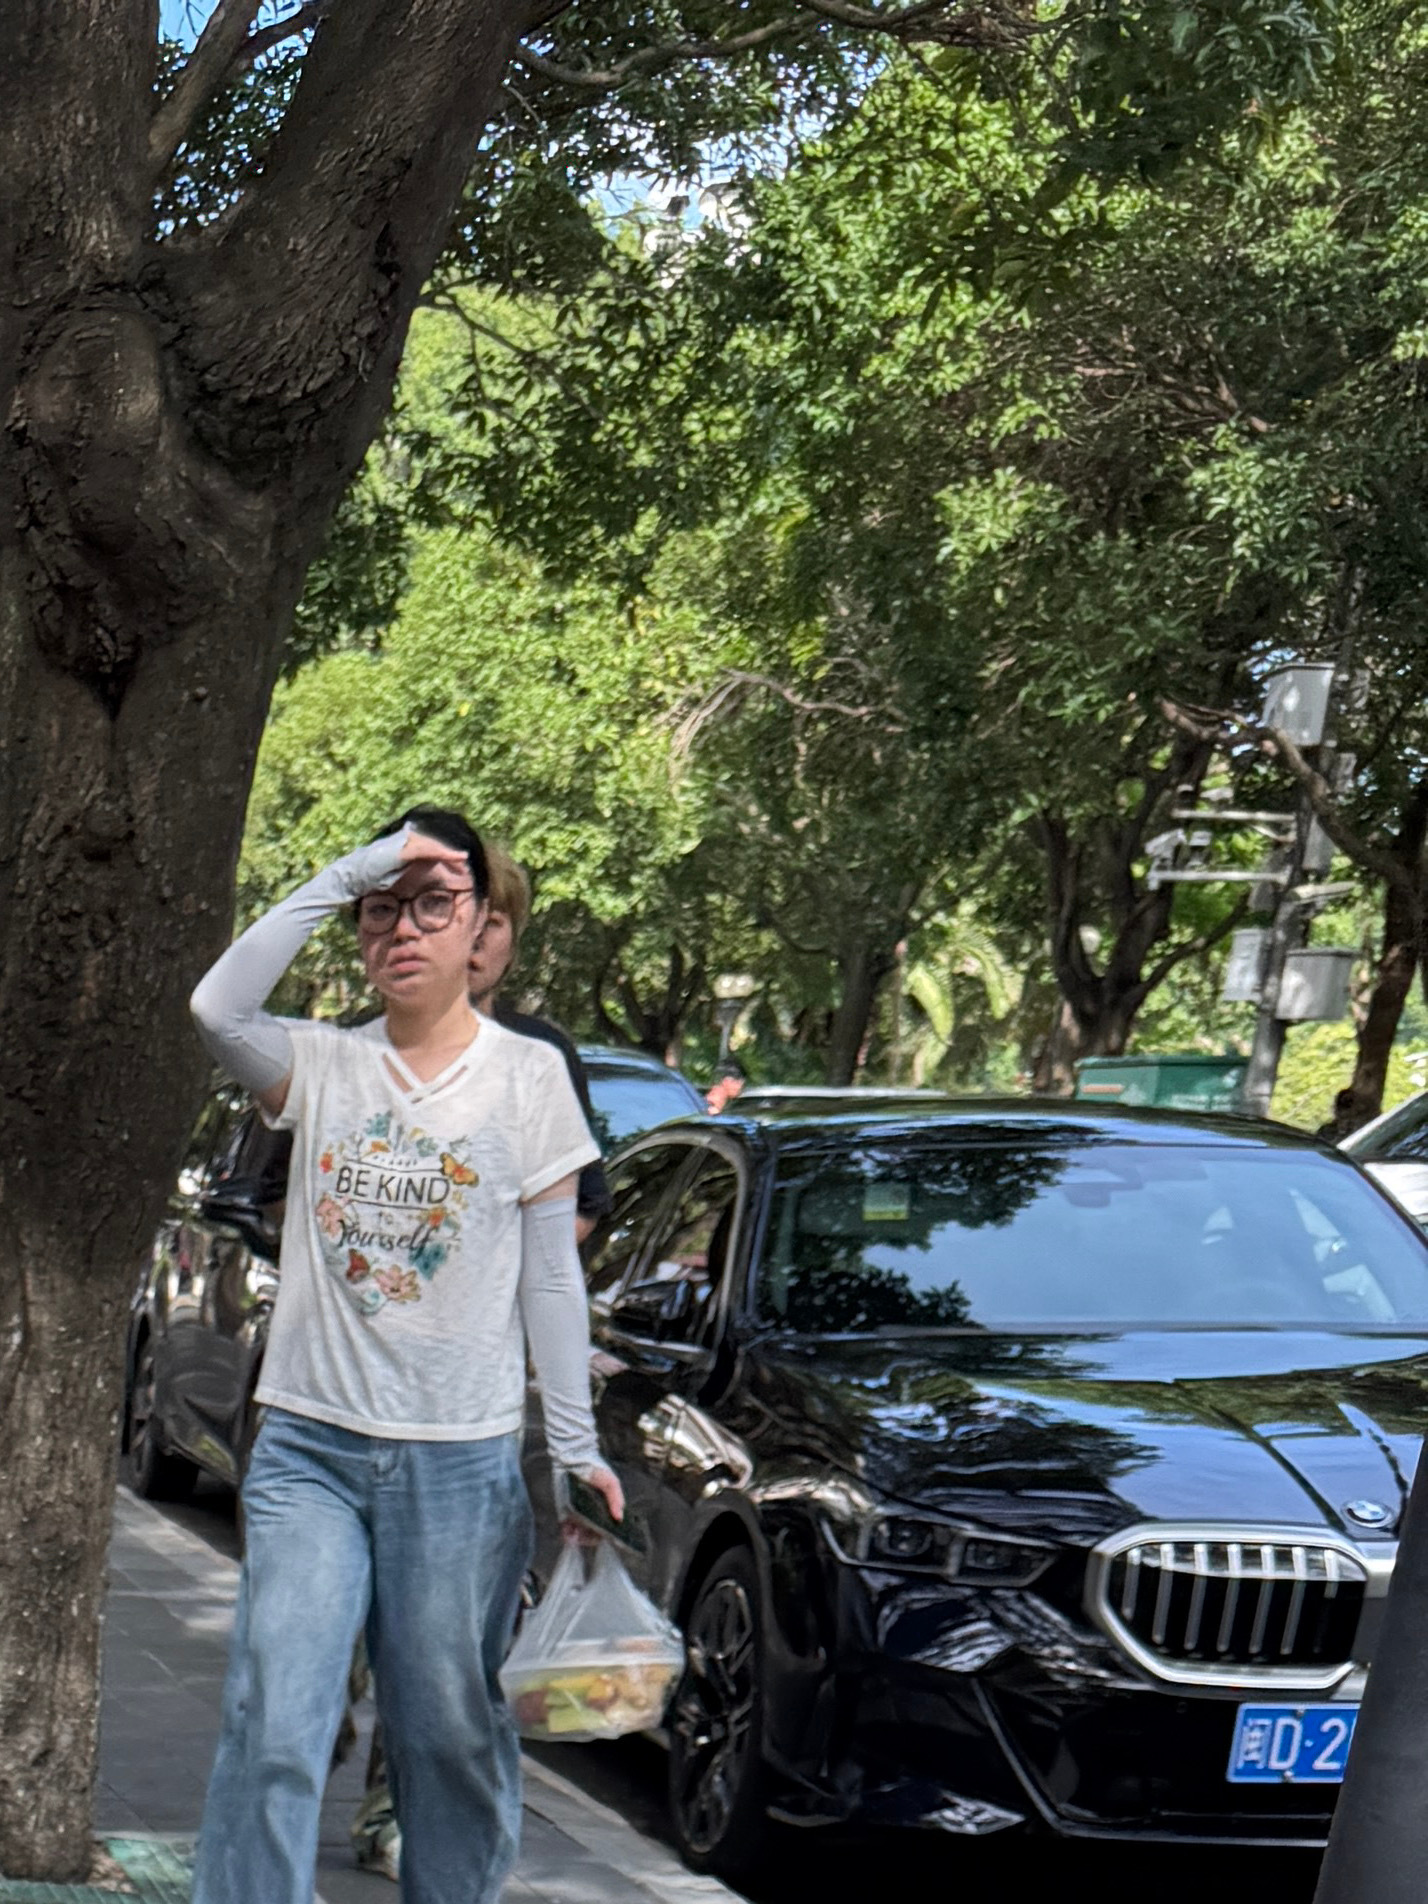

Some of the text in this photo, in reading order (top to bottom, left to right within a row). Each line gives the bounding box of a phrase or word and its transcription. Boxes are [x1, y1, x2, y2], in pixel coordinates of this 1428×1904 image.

[336, 1165, 451, 1205] BE KIND
[1237, 1717, 1357, 1771] 闽D·2
